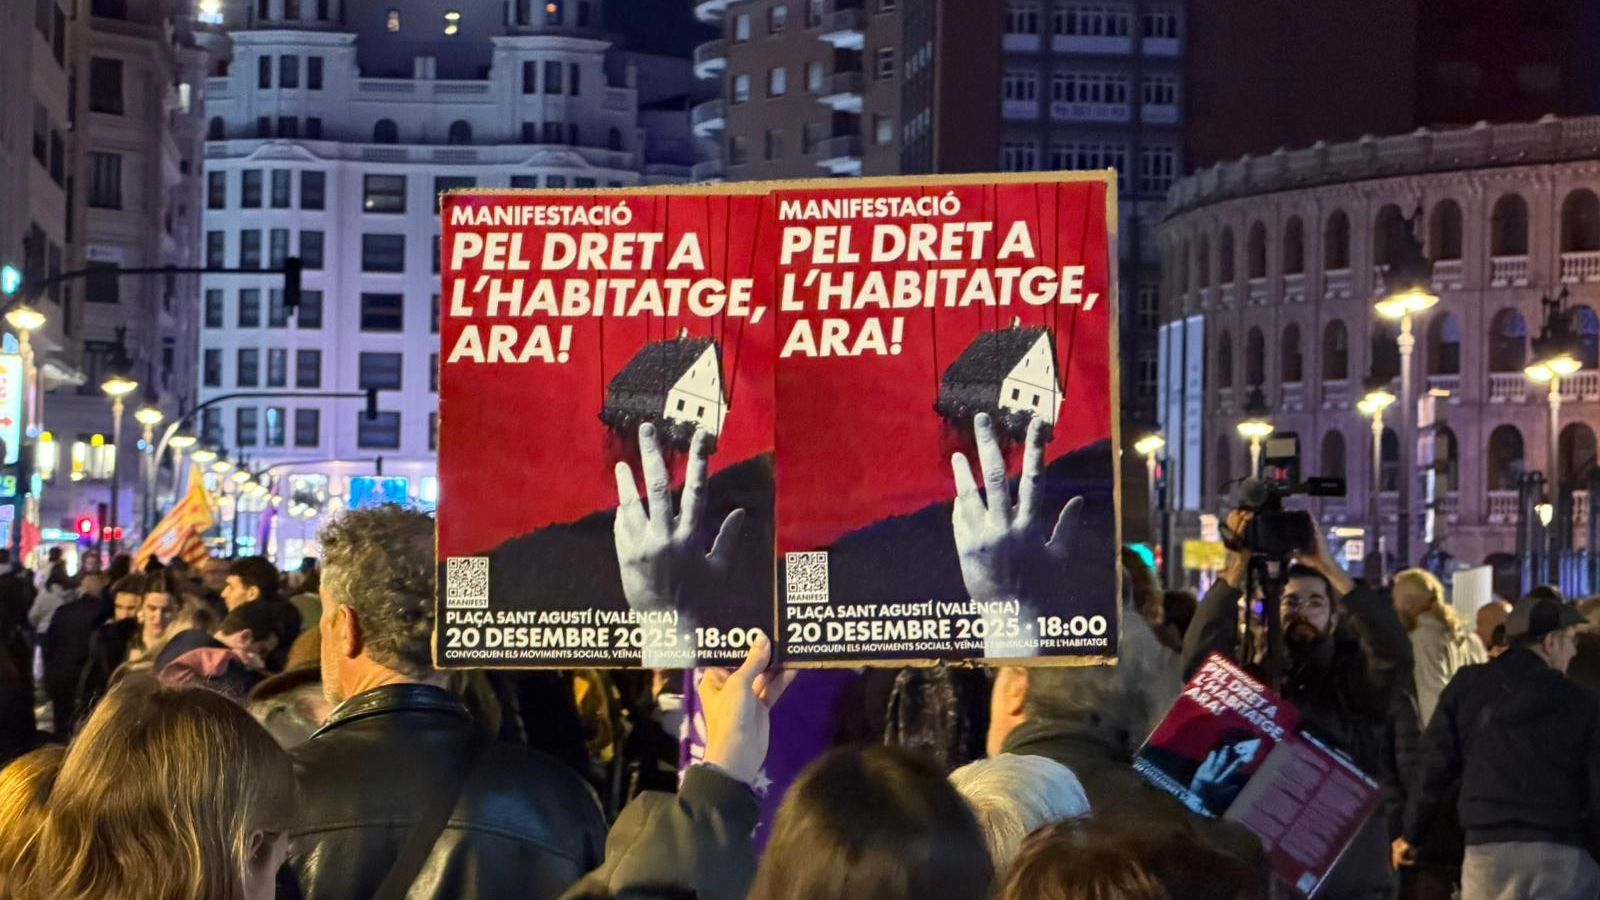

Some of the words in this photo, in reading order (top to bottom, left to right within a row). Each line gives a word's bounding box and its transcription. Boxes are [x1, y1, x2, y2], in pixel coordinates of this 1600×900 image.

[451, 201, 632, 225] MANIFESTACIÓ
[778, 191, 961, 220] MANIFESTACIÓ
[450, 232, 531, 271] PEL
[541, 232, 664, 271] DRET
[666, 232, 705, 271] A
[780, 225, 860, 265] PEL
[870, 221, 992, 263] DRET
[996, 220, 1036, 260] A
[450, 276, 766, 323] L'HABITATGE,
[780, 265, 1099, 312] L'HABITATGE,
[447, 325, 573, 364] ARA!
[779, 316, 904, 358] ARA!
[447, 599, 488, 607] MANIFEST
[787, 605, 835, 623] PLAÇA
[837, 604, 877, 619] SANT
[878, 600, 933, 617] AGUSTÍ
[936, 599, 1020, 618] (VALÈNCIA)
[788, 593, 828, 602] MANIFEST
[446, 611, 494, 629] PLAÇA
[496, 611, 537, 625] SANT
[538, 608, 592, 625] AGUSTÍ
[595, 609, 679, 627] (VALÈNCIA)
[787, 622, 821, 643] 20
[827, 620, 951, 641] DESEMBRE
[955, 617, 1020, 639] 2025
[1037, 615, 1107, 637] 18:00
[446, 628, 481, 649] 20
[485, 628, 609, 649] DESEMBRE
[614, 628, 678, 649] 2025
[695, 627, 764, 648] 18:00
[787, 644, 845, 654] CONVOQUEN
[847, 643, 860, 653] ELS
[862, 641, 914, 652] MOVIMENTS
[915, 640, 953, 651] SOCIALS,
[1040, 638, 1055, 648] PER
[1056, 637, 1108, 648] L'HABITATGE
[445, 650, 503, 659] CONVOQUEN
[505, 650, 519, 659] ELS
[520, 650, 572, 659] MOVIMENTS
[573, 649, 611, 660] SOCIALS,
[697, 650, 713, 659] PER
[1227, 679, 1268, 709] DRET
[1261, 705, 1278, 719] A
